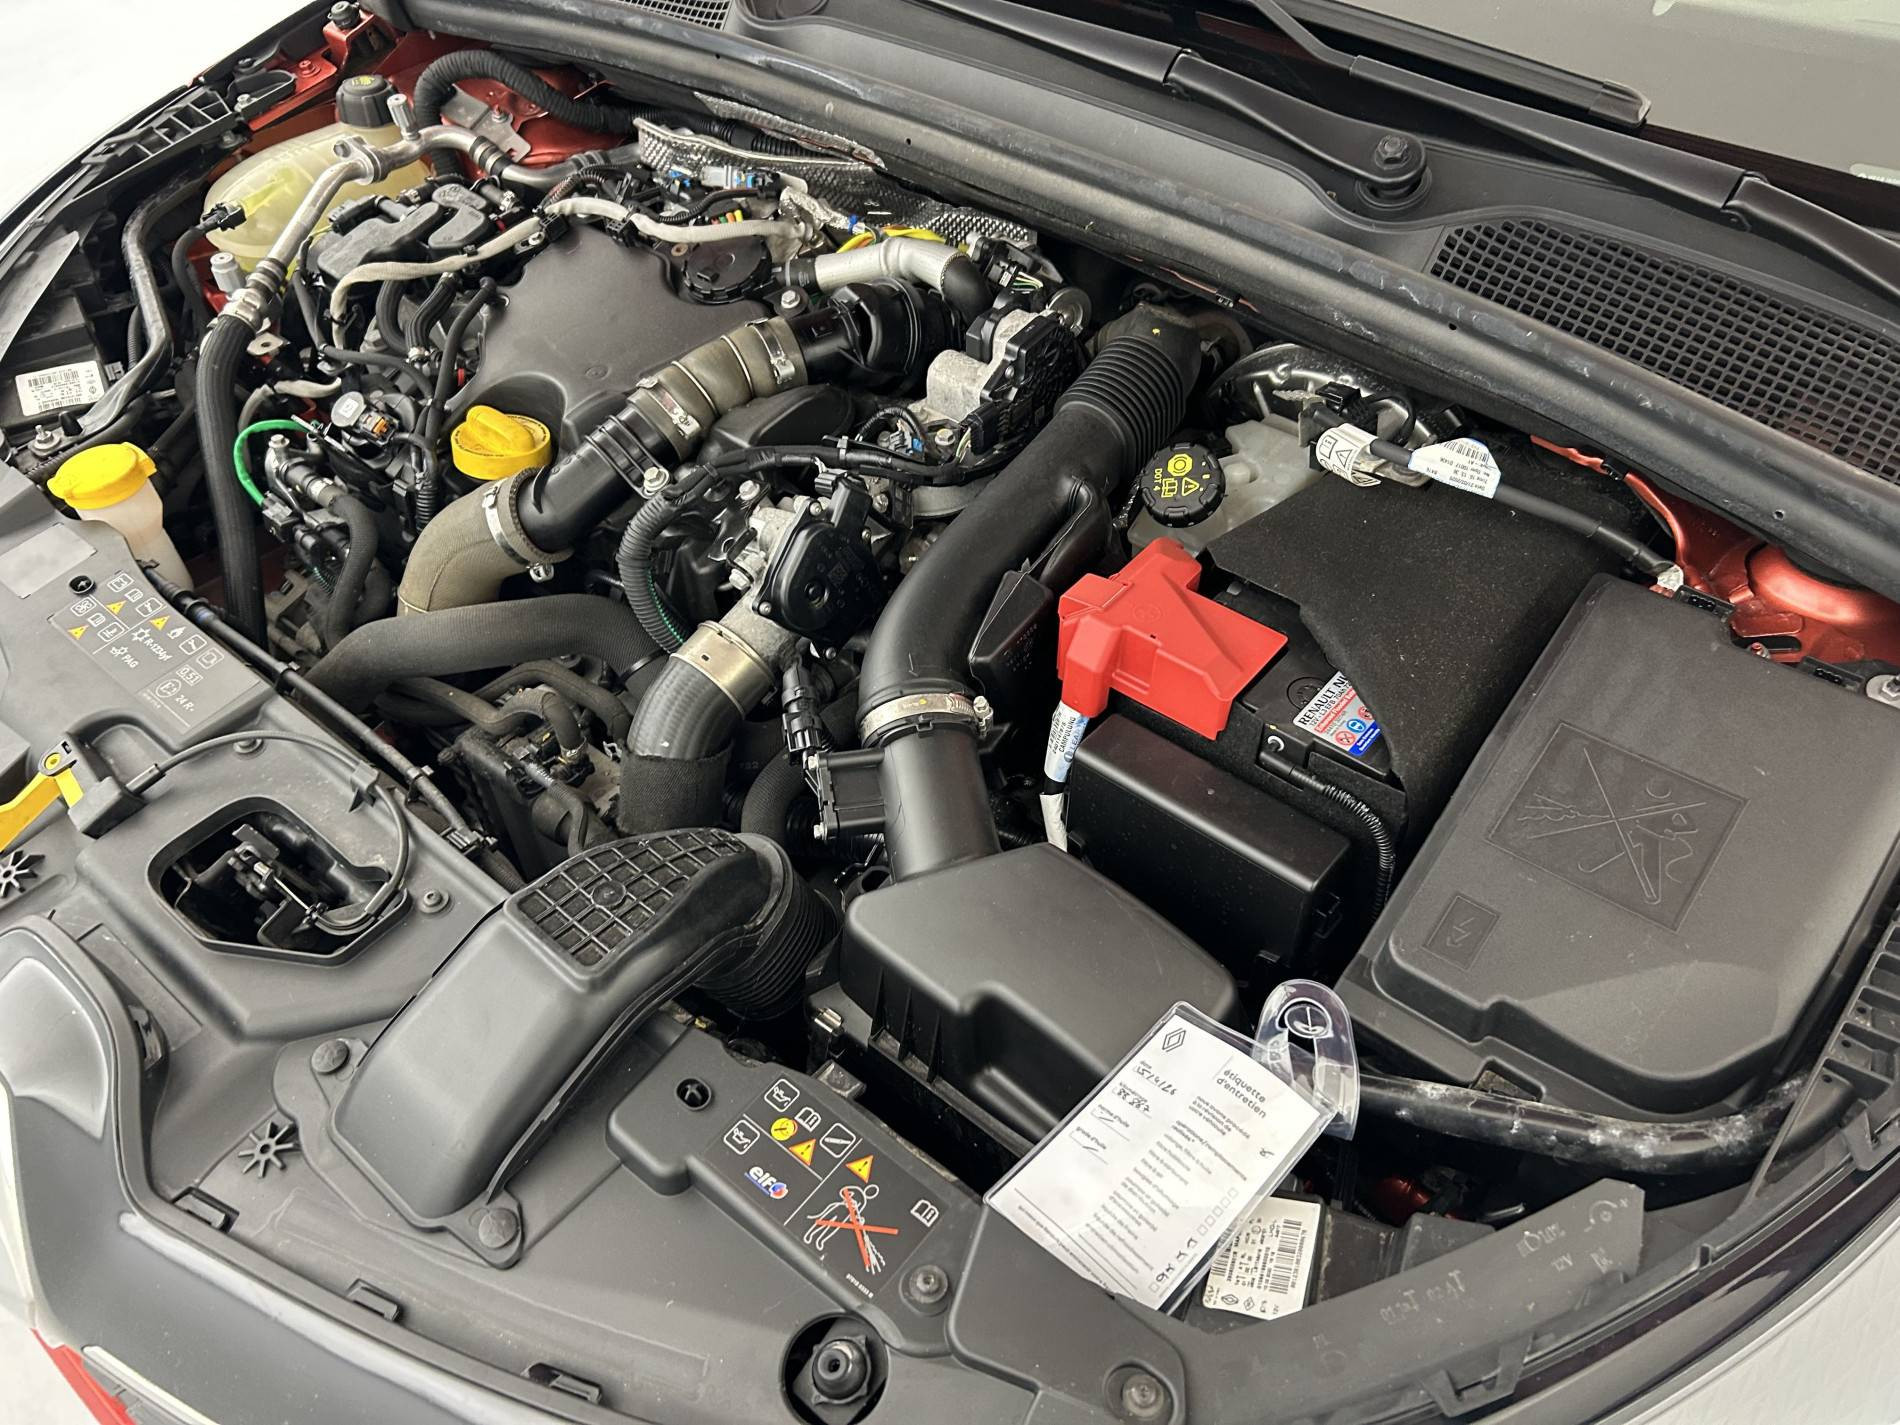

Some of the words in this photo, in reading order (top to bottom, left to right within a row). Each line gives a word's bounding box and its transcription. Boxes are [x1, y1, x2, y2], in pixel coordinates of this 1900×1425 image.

[1153, 468, 1162, 482] DOT
[122, 653, 139, 669] PAG
[1298, 687, 1336, 725] RENAULT
[1058, 716, 1075, 752] CAMPULUNG
[1216, 1077, 1267, 1117] d'entretien
[1223, 1068, 1266, 1102] étiquette
[749, 1166, 777, 1189] elf
